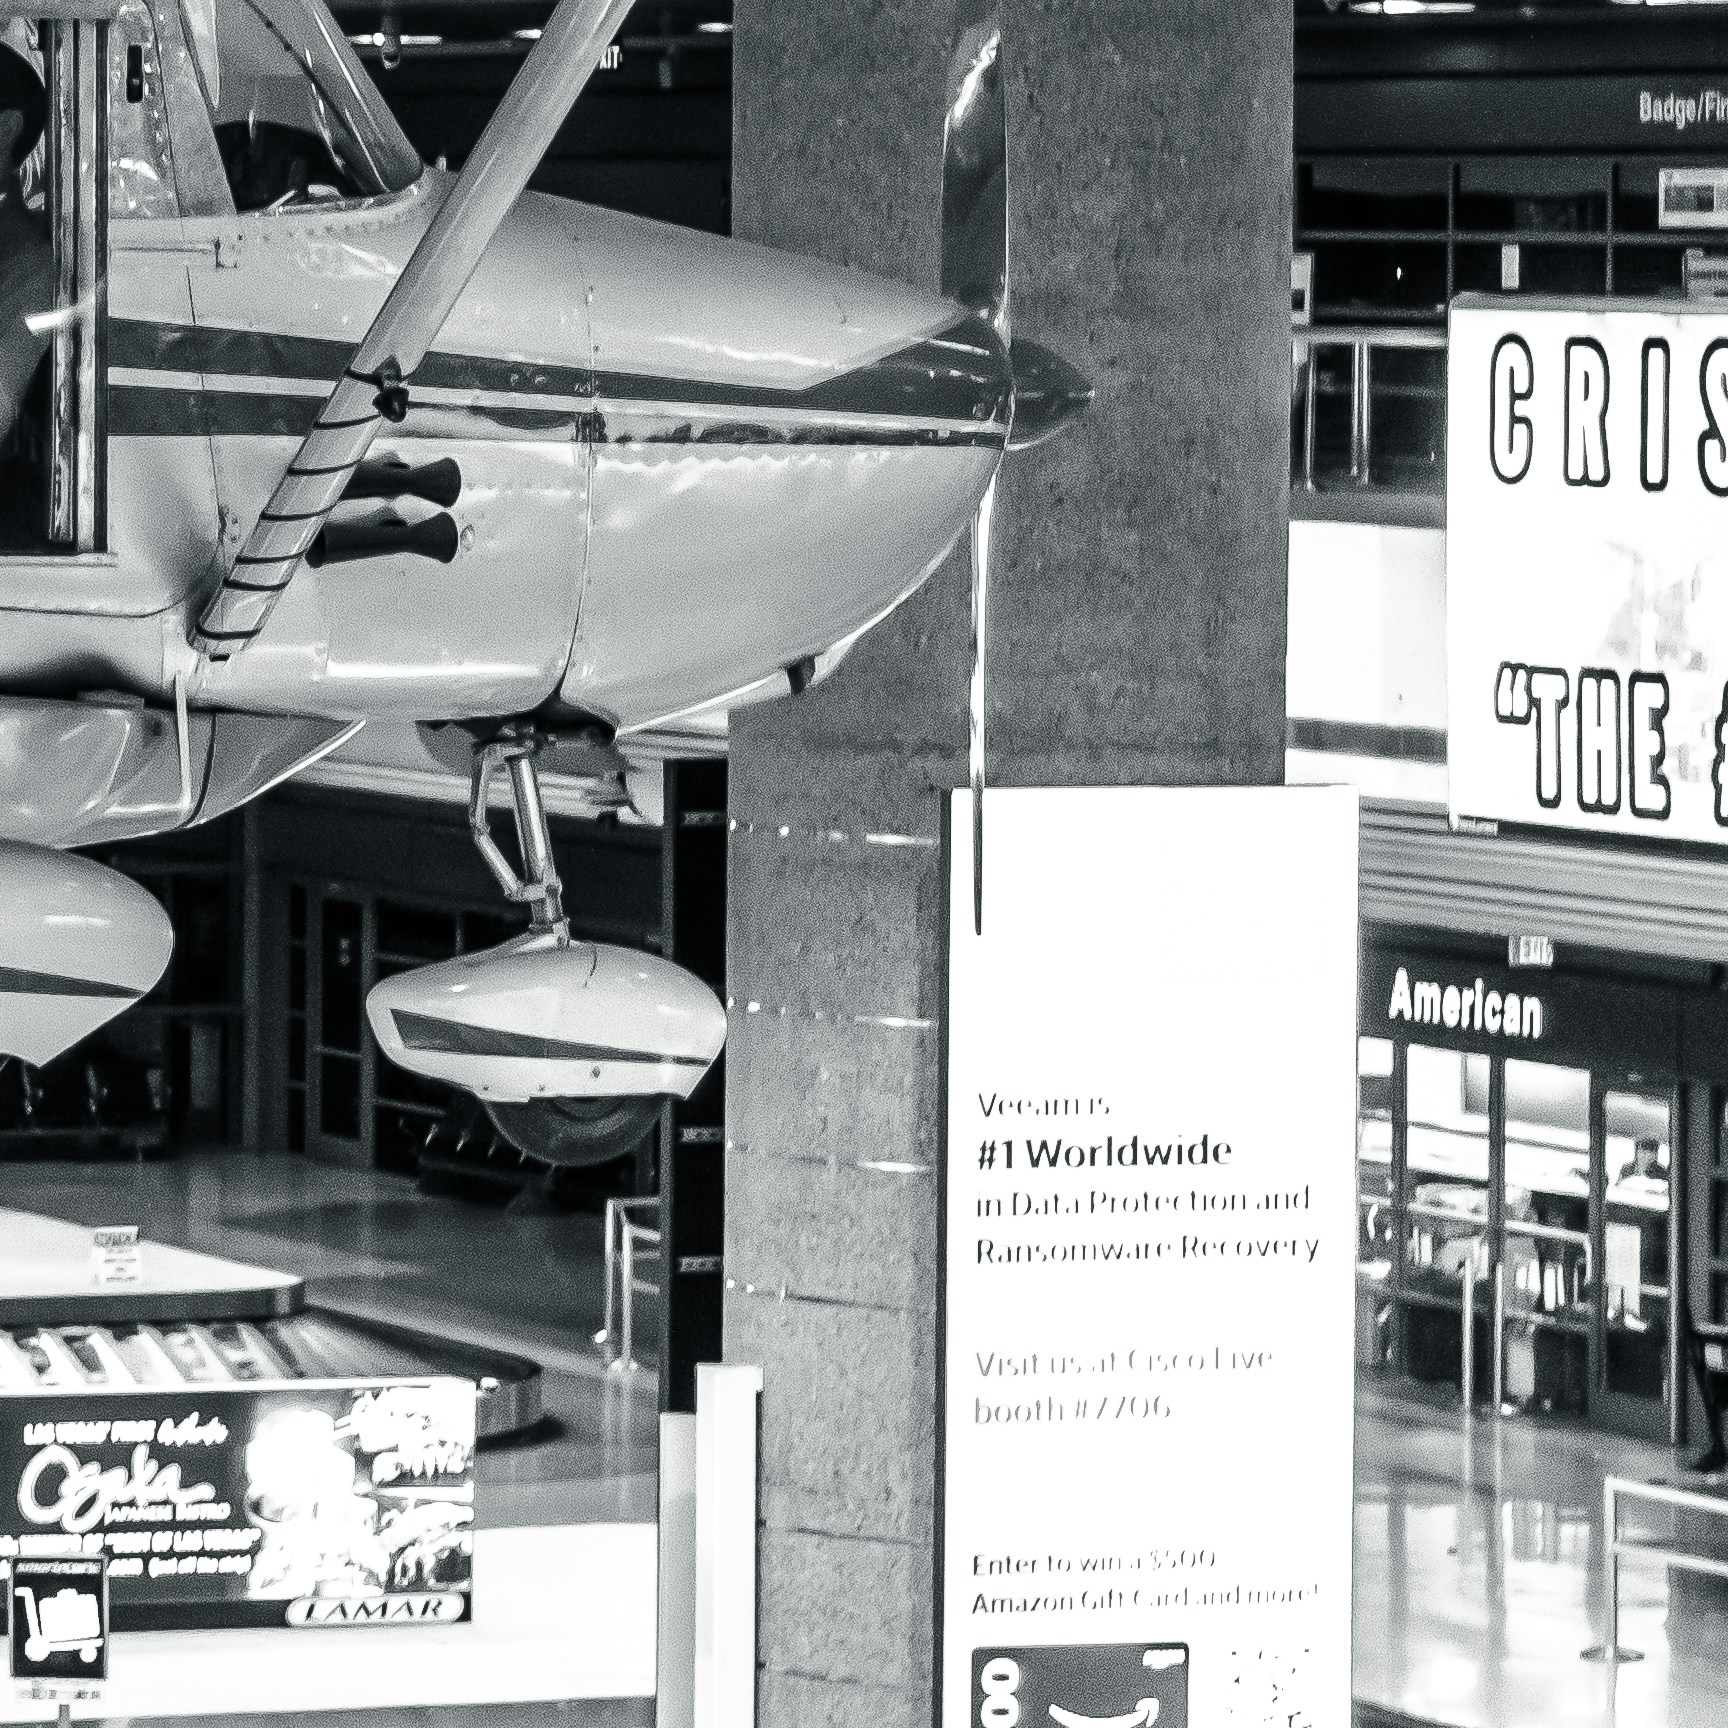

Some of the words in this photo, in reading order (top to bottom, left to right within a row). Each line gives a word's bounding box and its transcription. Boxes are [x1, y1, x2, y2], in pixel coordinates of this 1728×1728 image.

[1388, 966, 1544, 1041] American
[978, 1092, 1079, 1118] Veeam
[977, 1139, 1014, 1171] #1
[1026, 1133, 1233, 1169] Worldwide
[1011, 1190, 1080, 1217] Data
[1089, 1188, 1247, 1215] Protection
[1256, 1184, 1310, 1211] and
[976, 1237, 1172, 1265] Ransomware
[1181, 1234, 1320, 1264] Recovery
[975, 1350, 1039, 1377] Visit
[974, 1394, 1064, 1425] booth
[973, 1553, 1039, 1577] Enter
[971, 1592, 1074, 1615] Amazon
